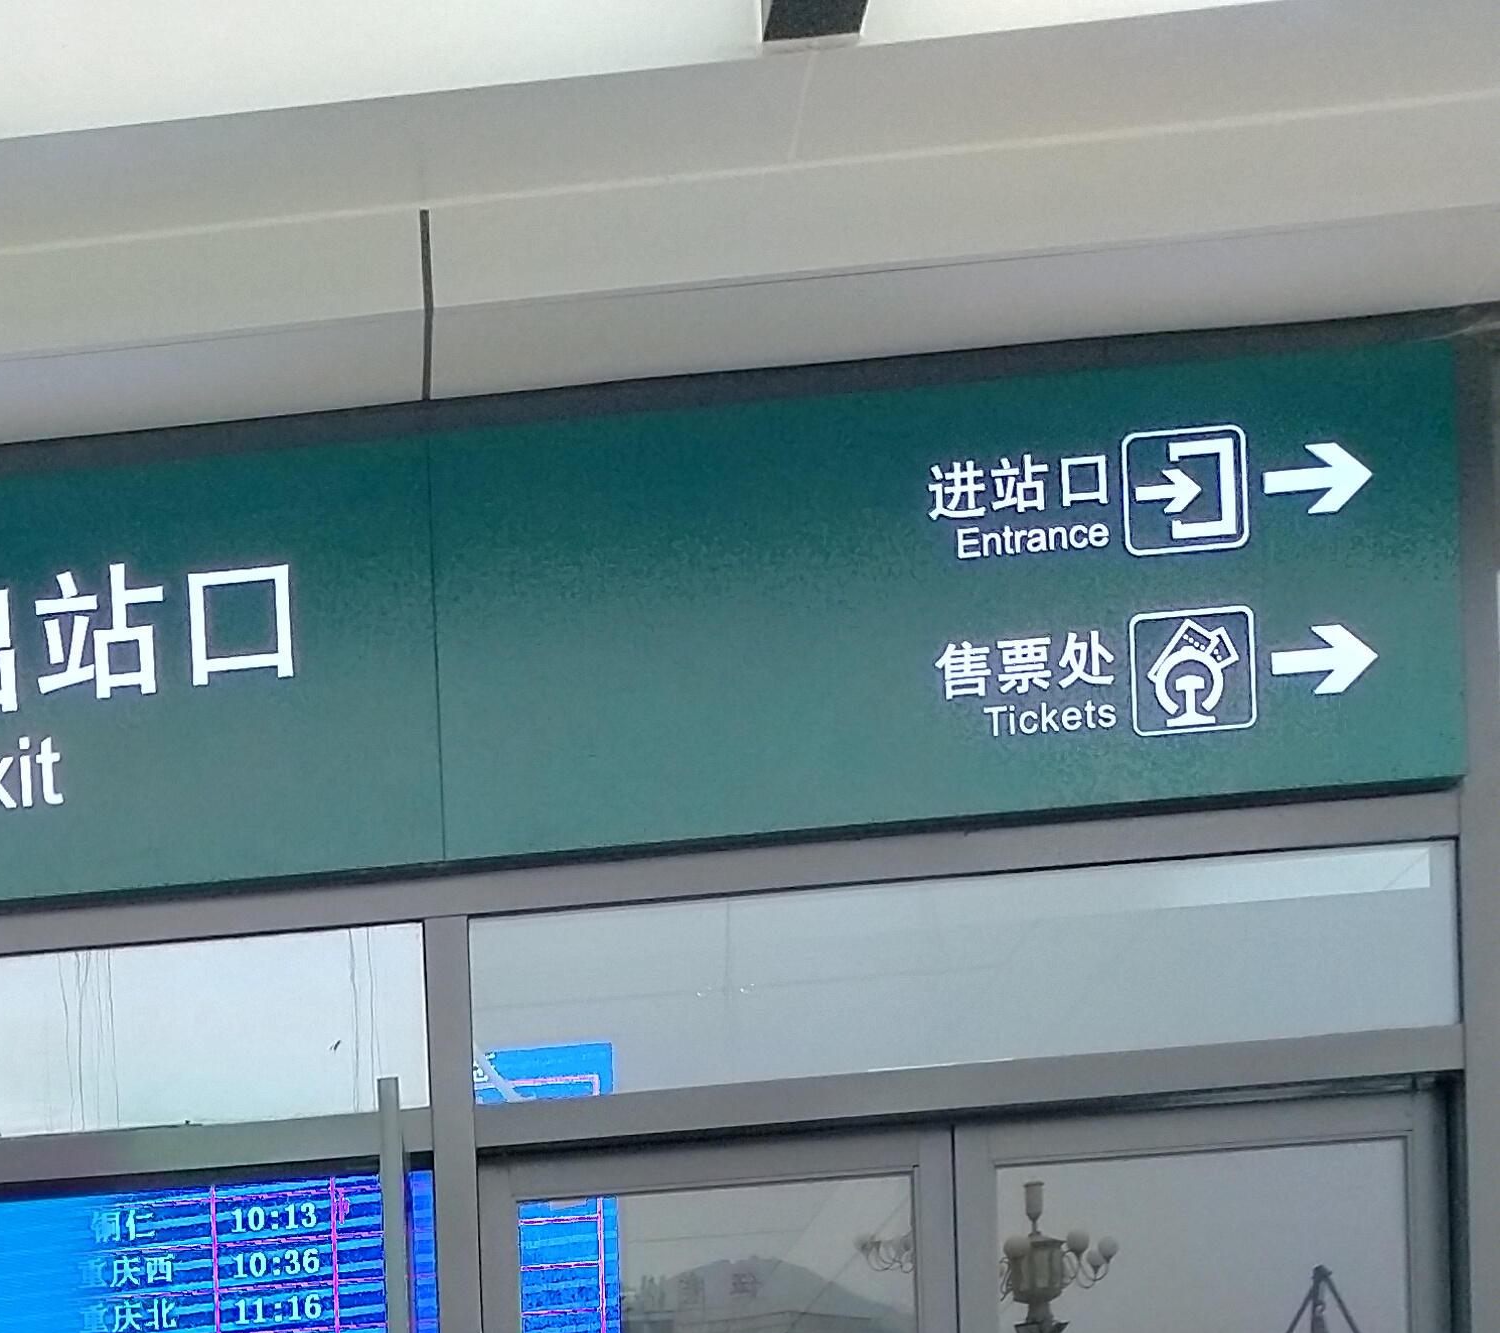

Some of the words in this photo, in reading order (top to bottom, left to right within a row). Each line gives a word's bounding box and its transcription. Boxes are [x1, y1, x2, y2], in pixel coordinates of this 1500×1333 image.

[927, 454, 1110, 520] 进站口
[956, 519, 1110, 559] Entrance
[935, 631, 1116, 699] 售票处
[983, 700, 1117, 737] Tickets
[231, 1202, 318, 1234] 10:13
[233, 1249, 320, 1279] 10:36
[80, 1298, 177, 1333] 重庆北
[235, 1294, 323, 1325] 11:16
